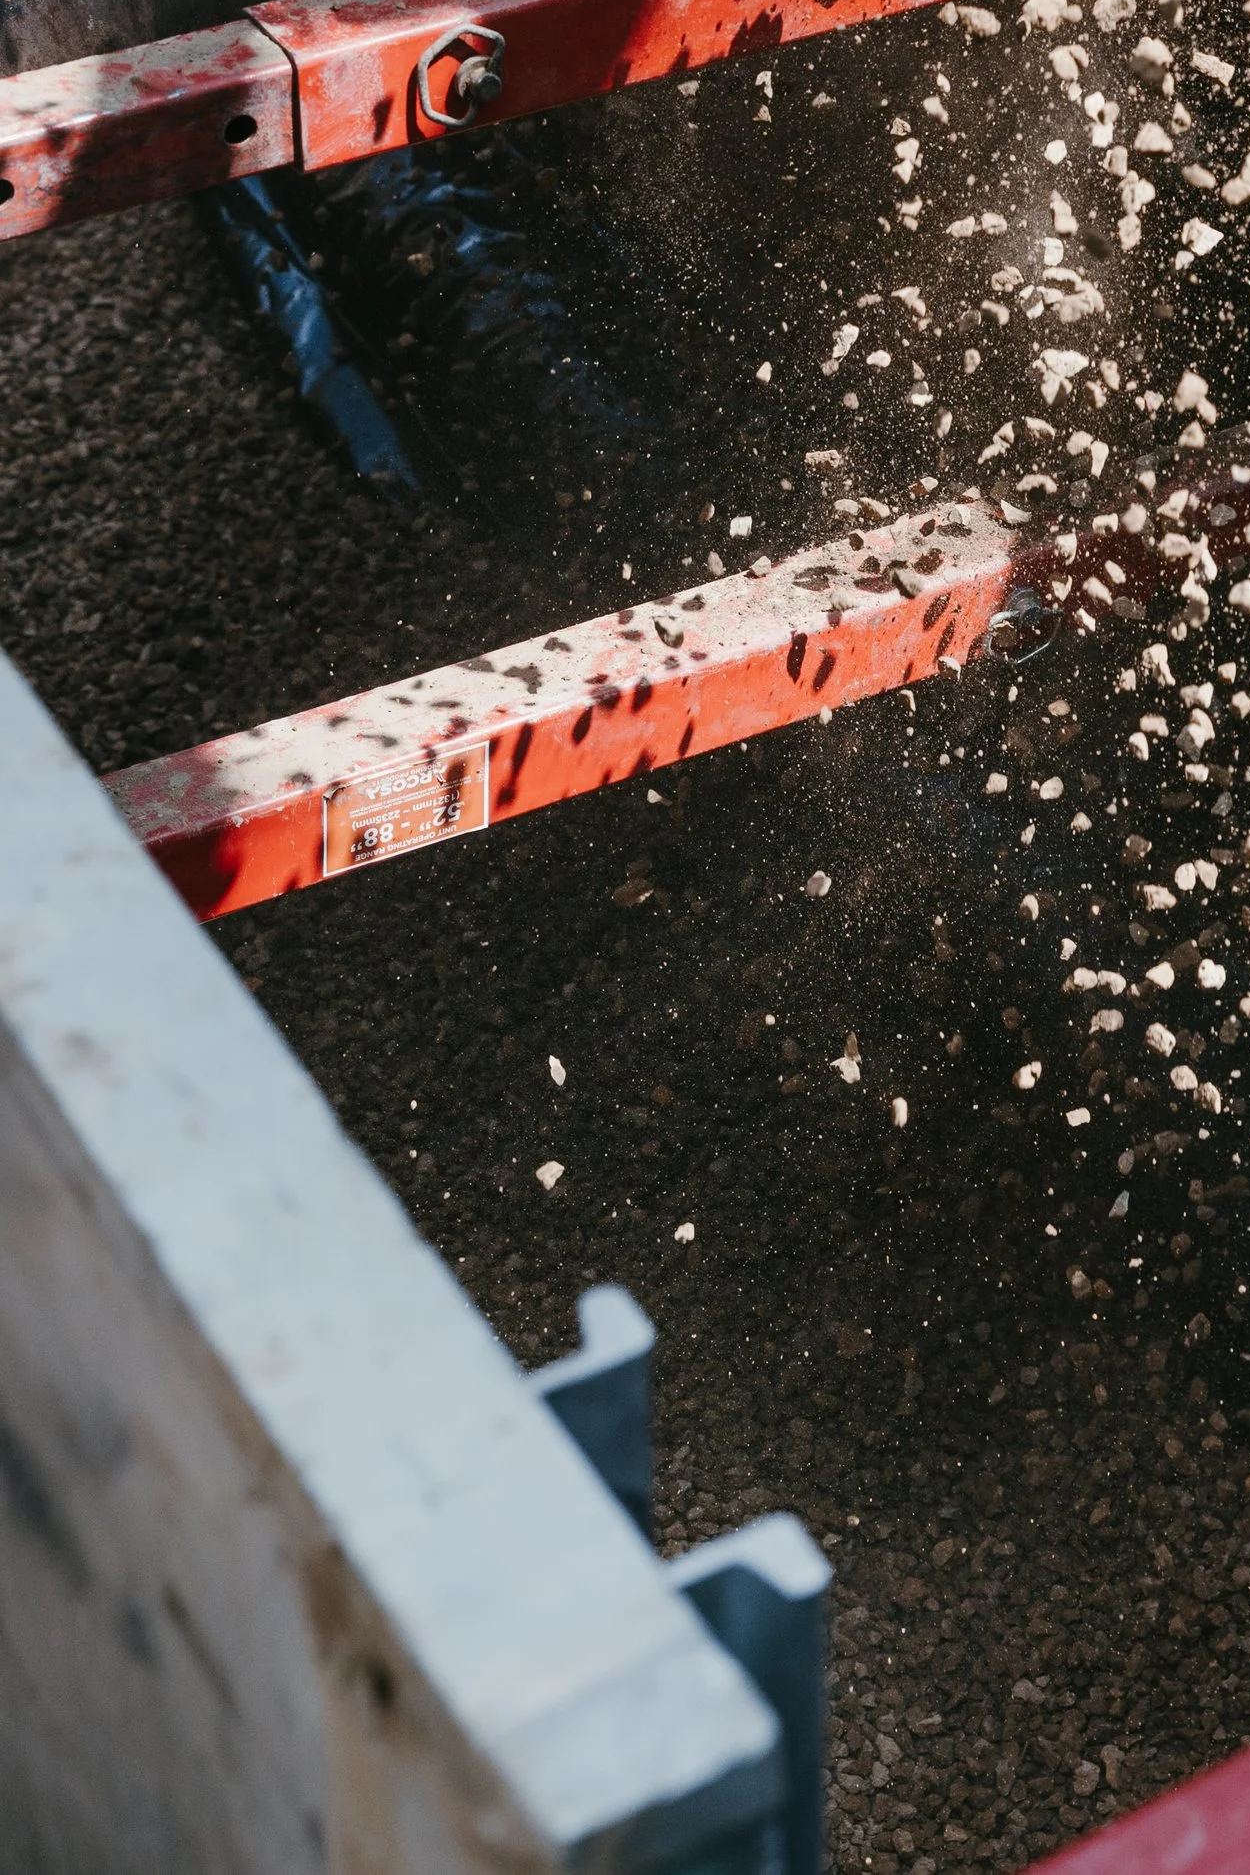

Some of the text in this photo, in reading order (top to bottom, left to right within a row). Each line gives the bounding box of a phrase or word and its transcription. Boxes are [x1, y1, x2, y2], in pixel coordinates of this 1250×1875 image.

[365, 764, 447, 800] ARCOSA
[412, 790, 460, 813] (1321mm
[352, 808, 400, 831] 2235mm)
[355, 824, 456, 861] UNIT OPERATING RANGE
